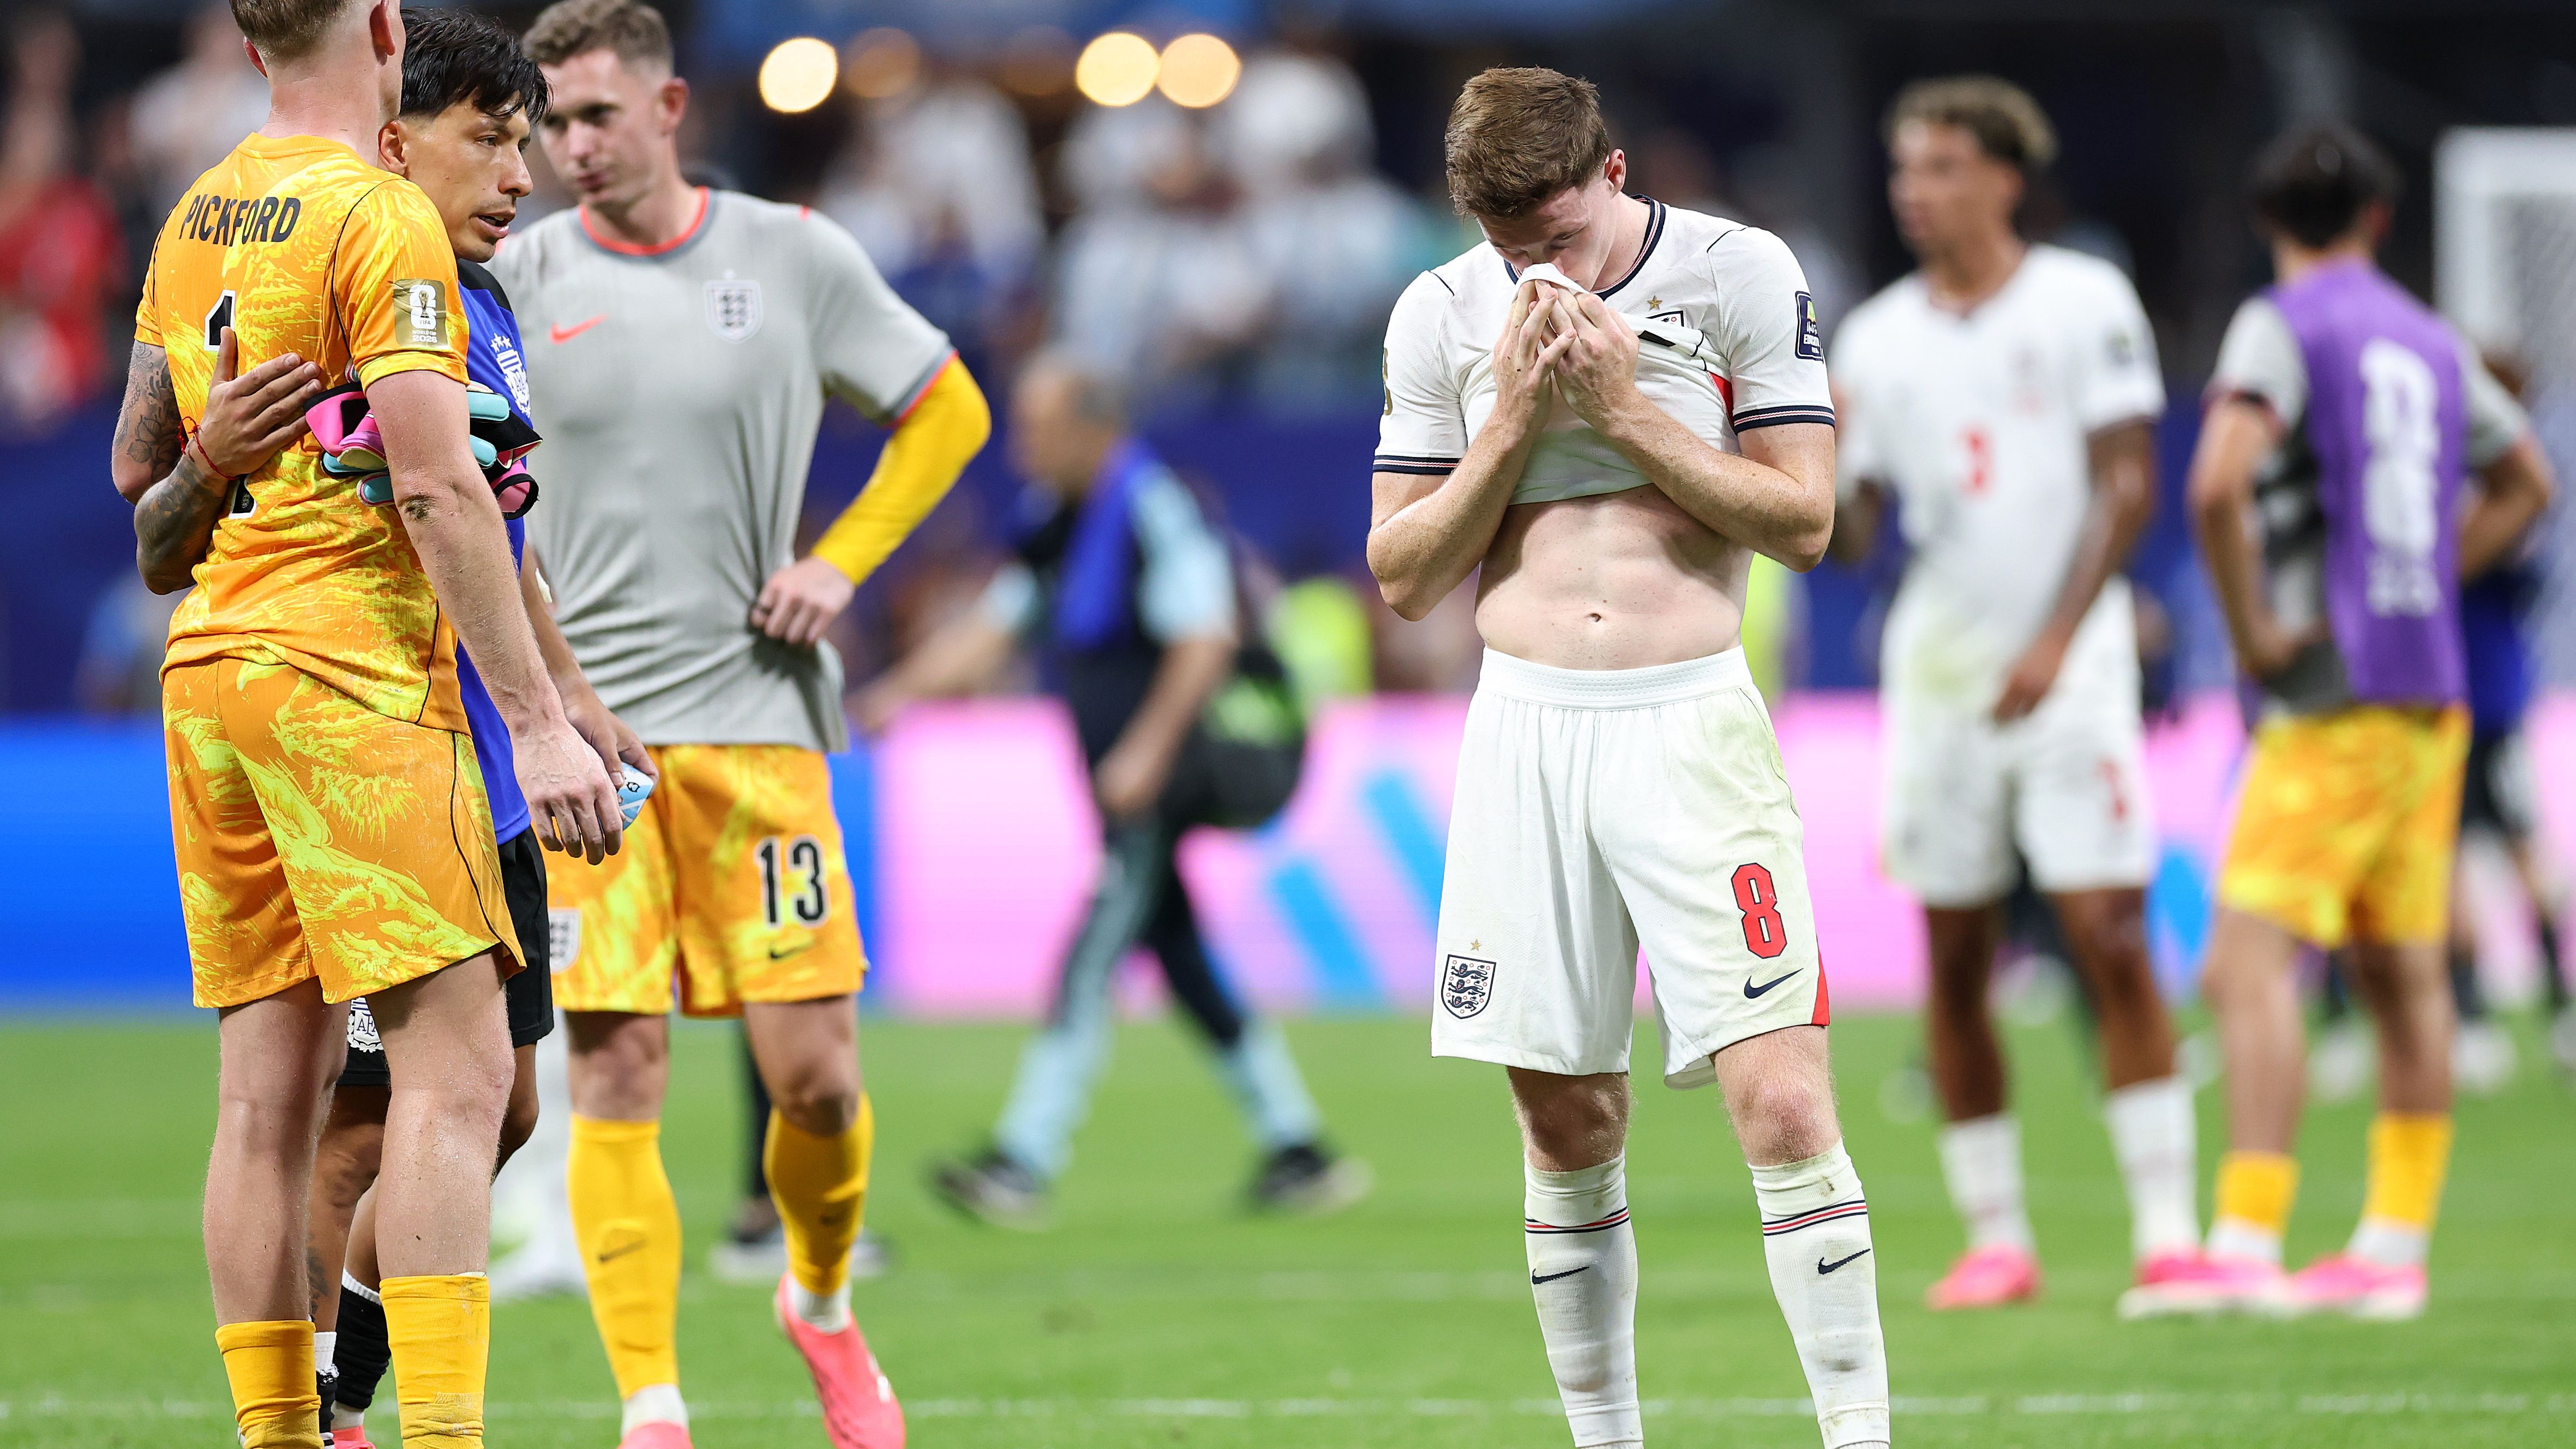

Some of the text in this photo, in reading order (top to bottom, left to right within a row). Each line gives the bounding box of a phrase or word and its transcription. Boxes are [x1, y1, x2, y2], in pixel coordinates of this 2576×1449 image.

[178, 194, 301, 247] PICKFORD
[412, 334, 437, 343] 2026
[756, 838, 828, 927] 13
[1731, 862, 1788, 959] 8
